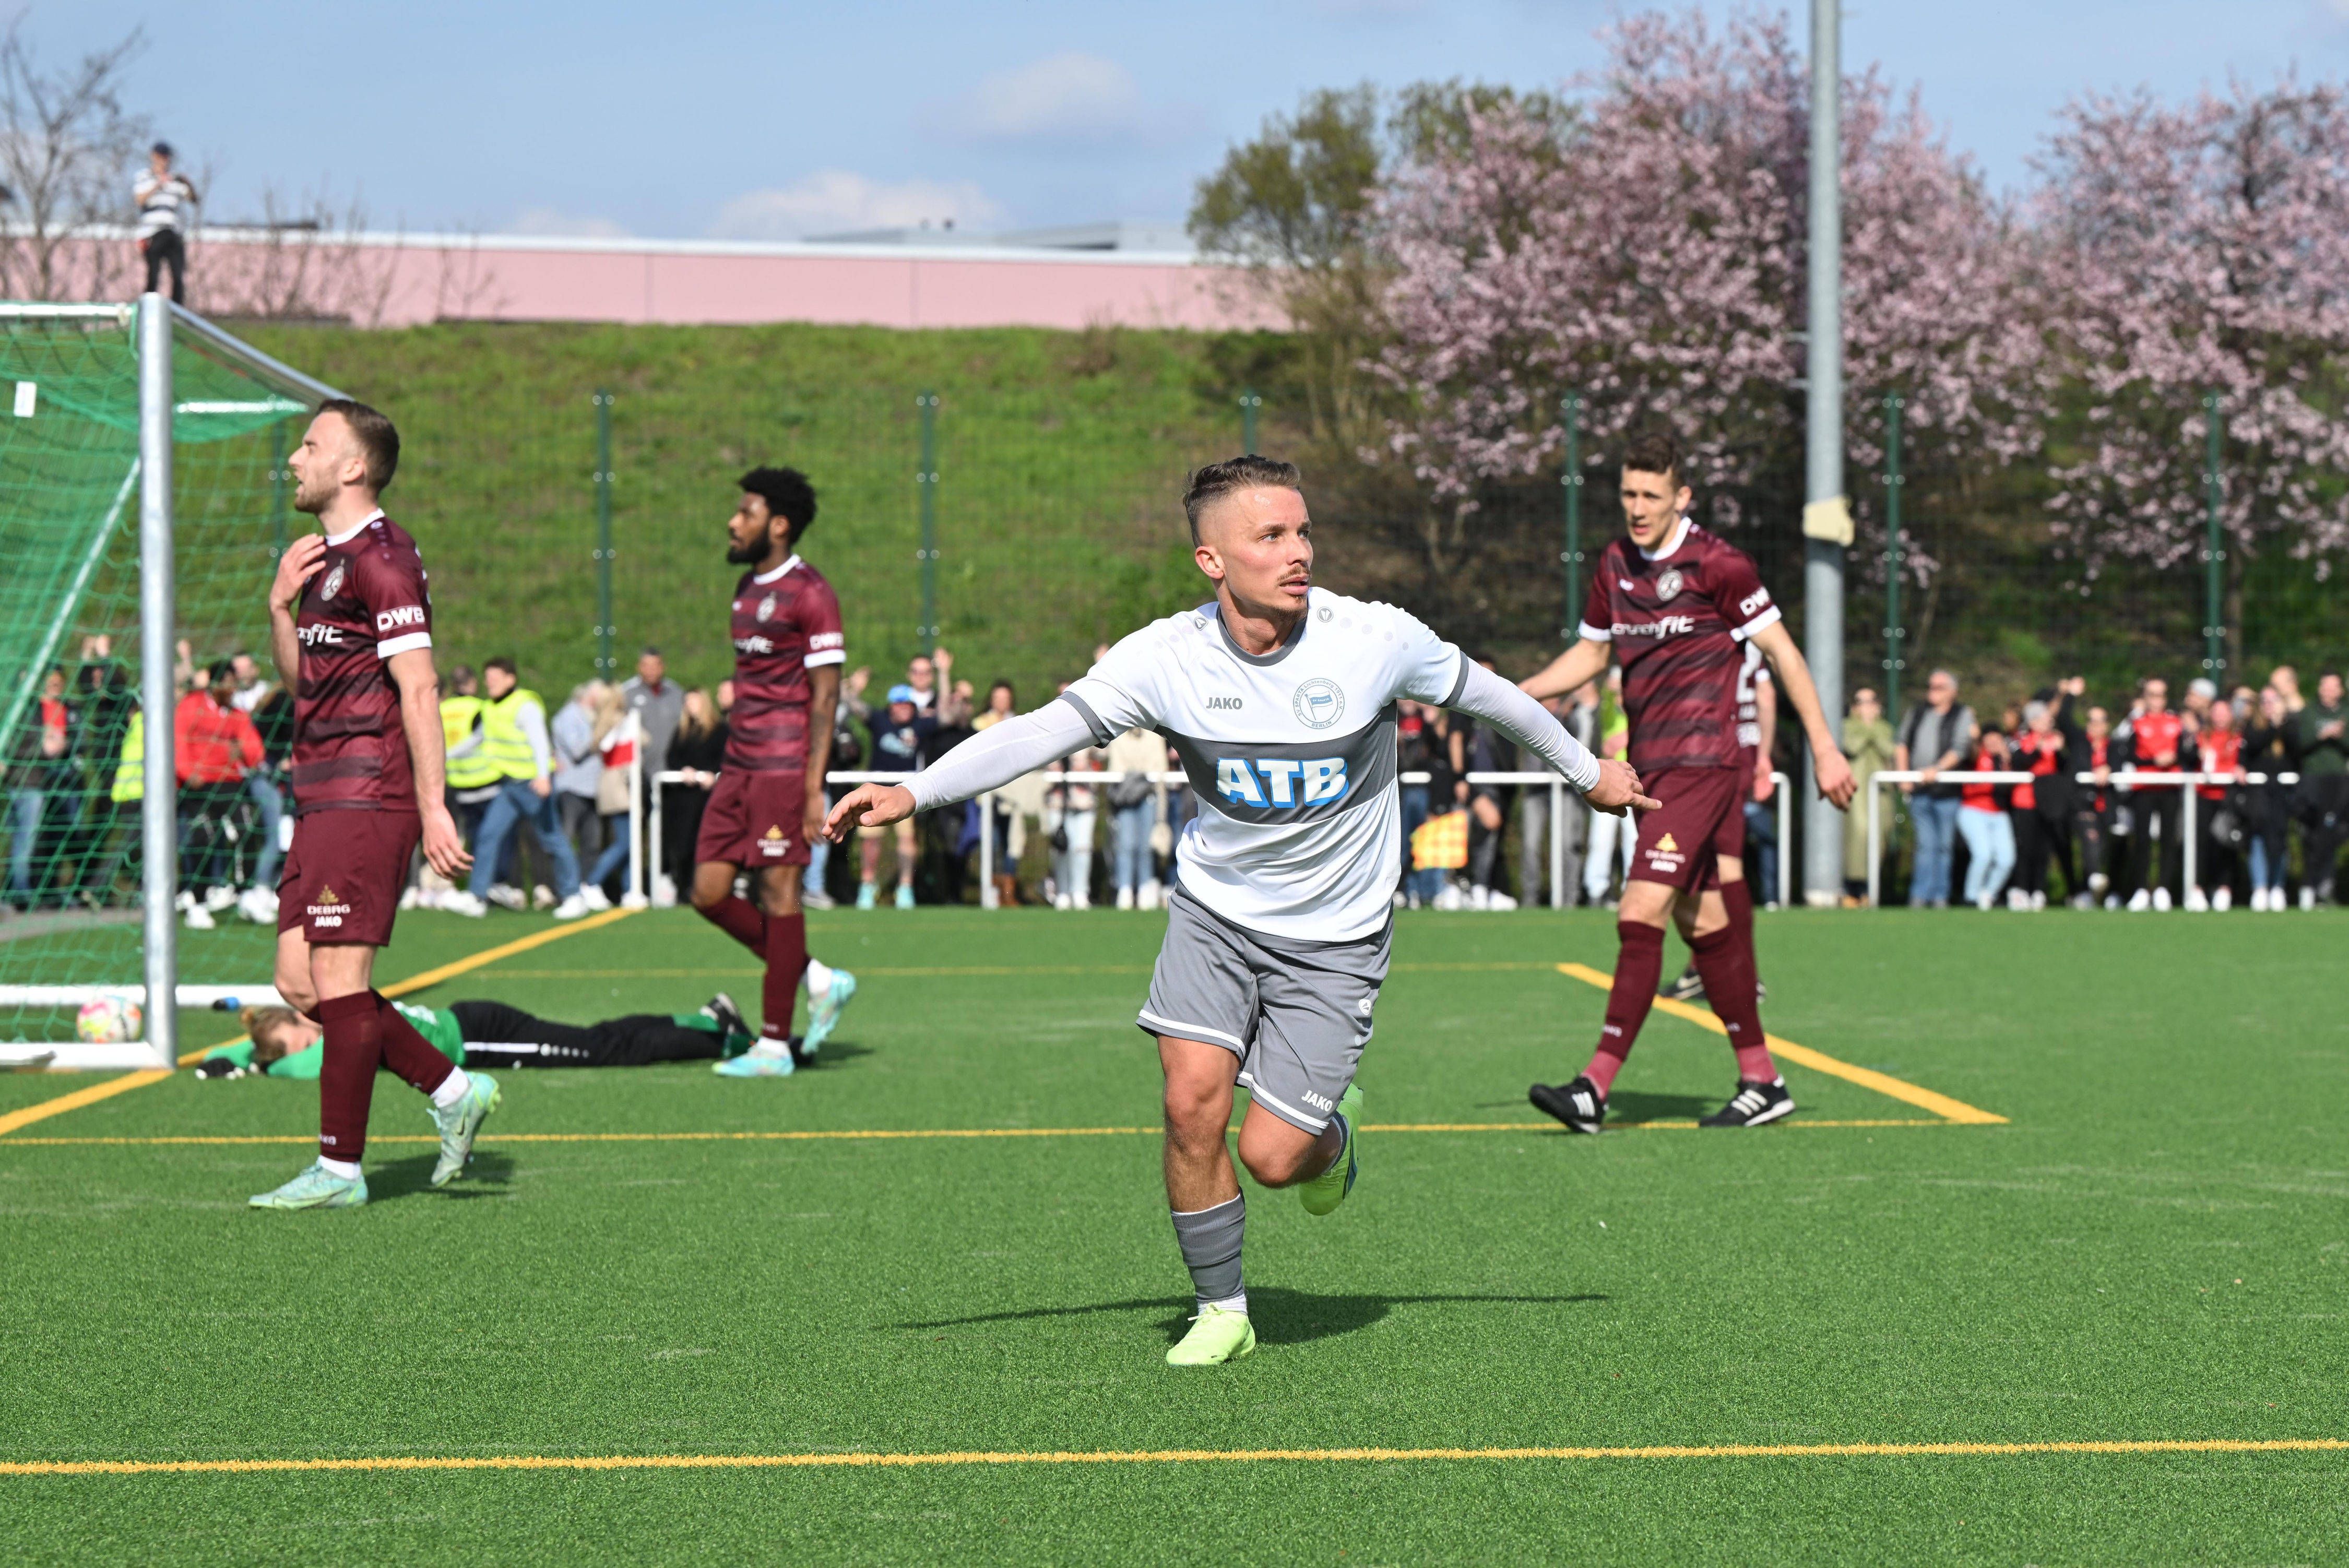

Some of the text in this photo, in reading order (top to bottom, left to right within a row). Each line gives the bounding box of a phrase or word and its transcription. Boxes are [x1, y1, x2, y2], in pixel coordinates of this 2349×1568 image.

[1739, 586, 1770, 616] DW
[377, 607, 425, 631] DWB
[1206, 697, 1243, 710] JAKO
[1295, 688, 1304, 707] SPARTA
[1217, 757, 1349, 808] ATB
[314, 915, 342, 928] JAKO
[1301, 1089, 1333, 1112] JAKO
